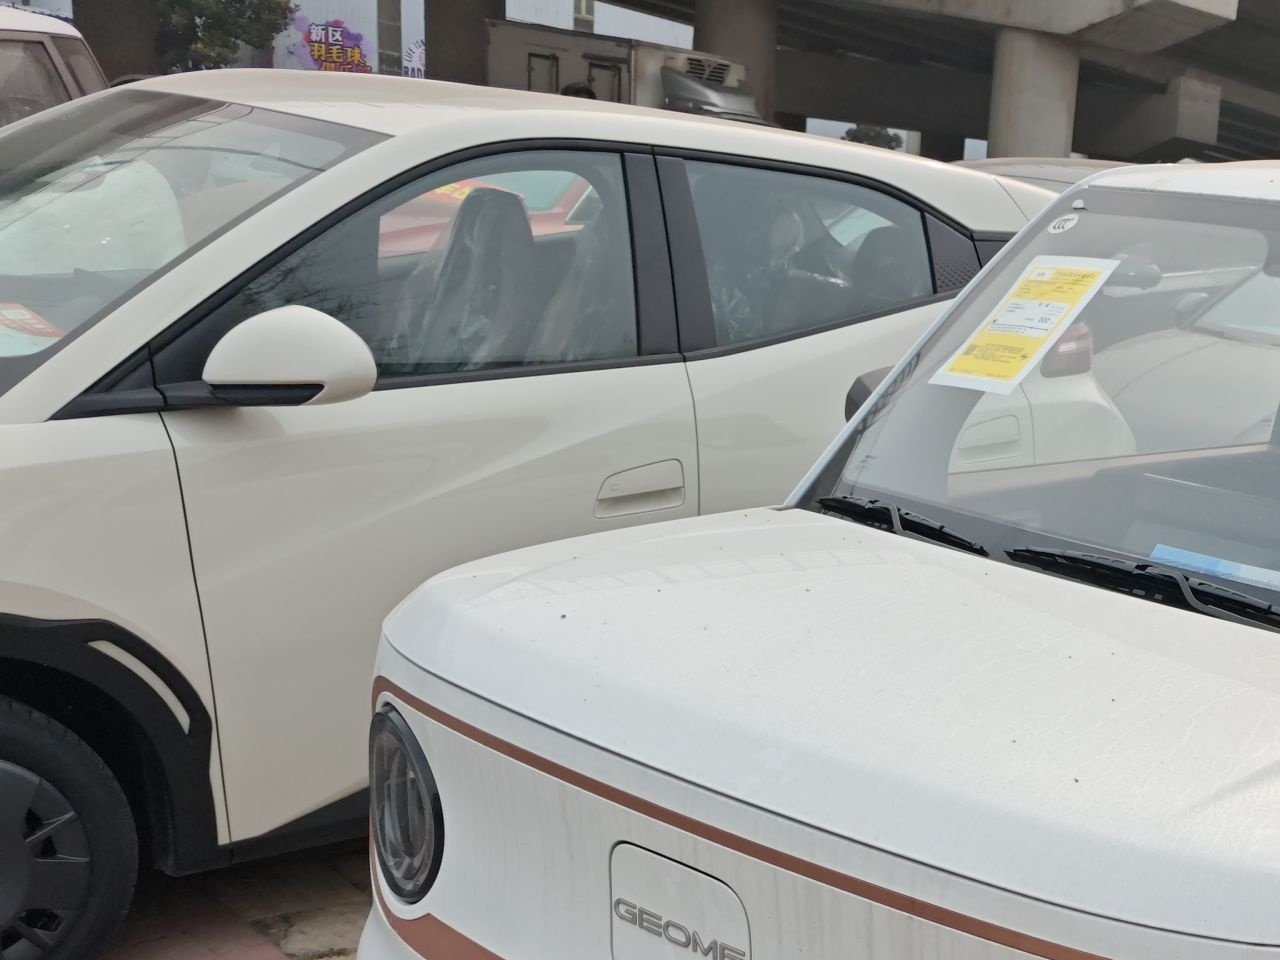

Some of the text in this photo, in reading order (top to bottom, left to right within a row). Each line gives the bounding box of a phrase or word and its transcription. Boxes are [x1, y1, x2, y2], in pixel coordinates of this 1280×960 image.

[309, 23, 344, 45] 新区
[309, 43, 367, 67] 羽毛球
